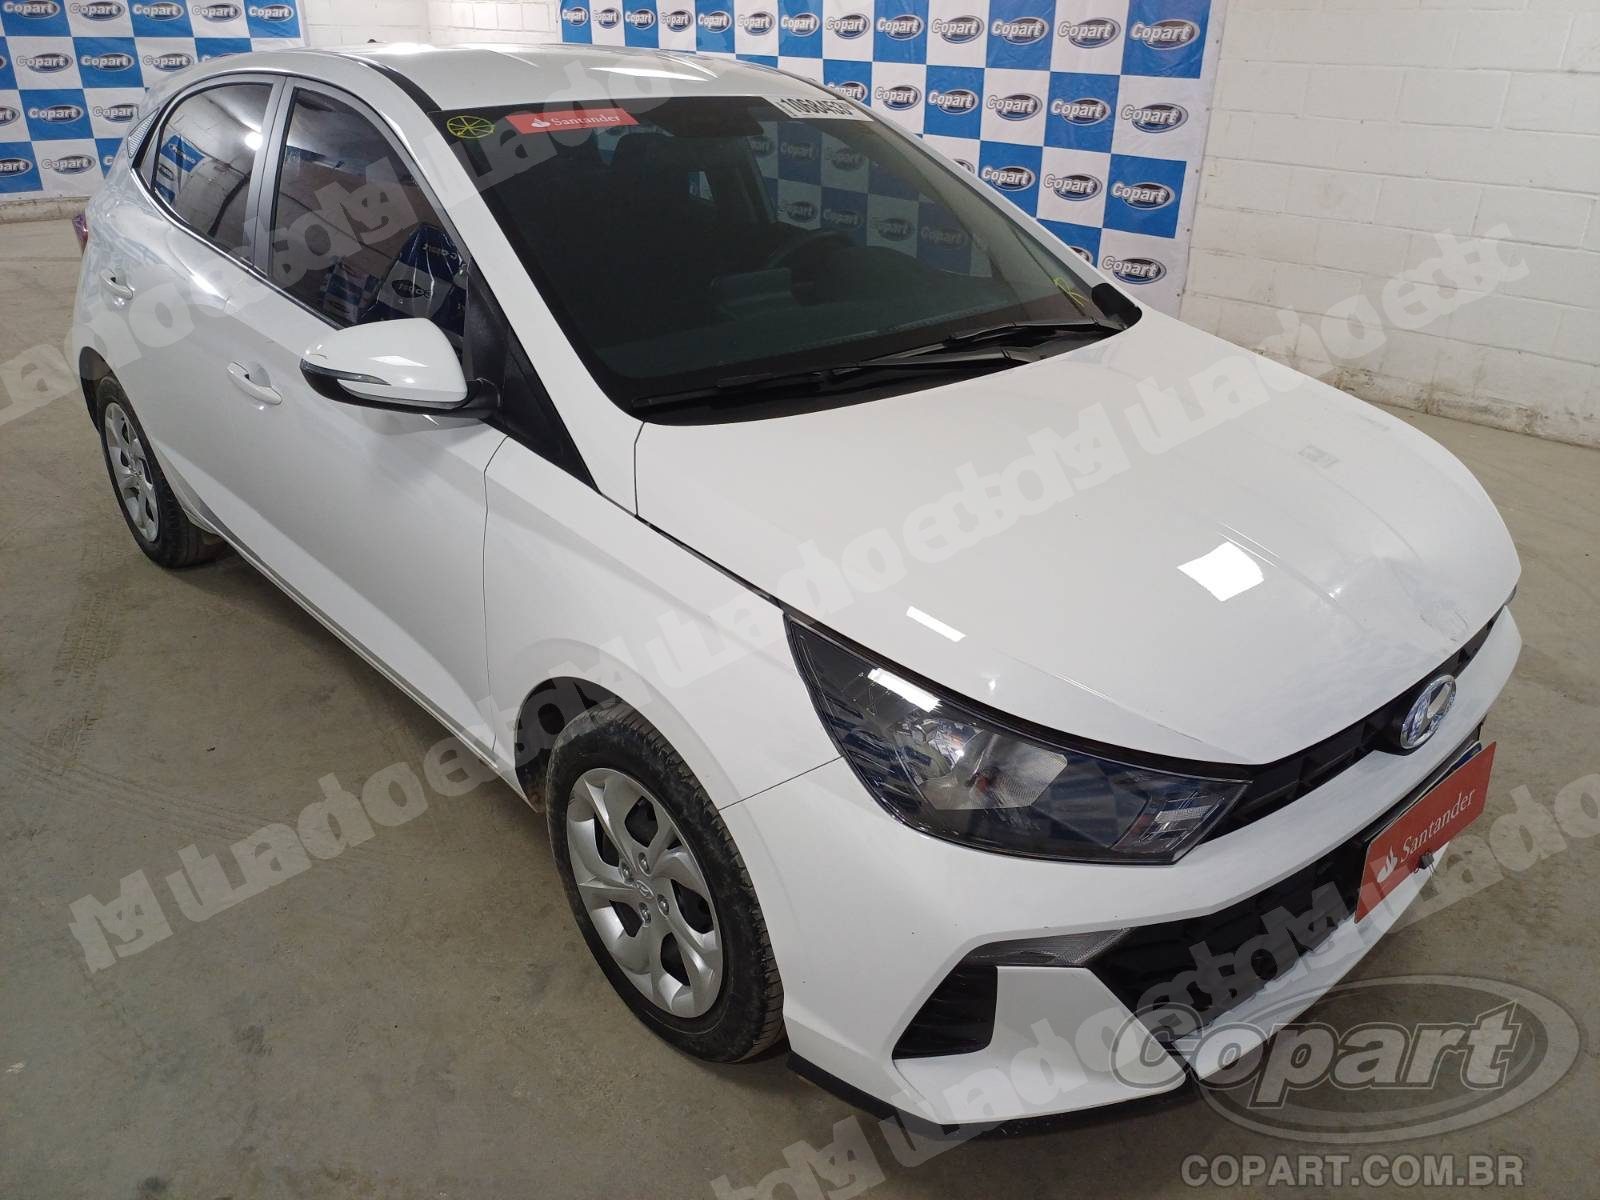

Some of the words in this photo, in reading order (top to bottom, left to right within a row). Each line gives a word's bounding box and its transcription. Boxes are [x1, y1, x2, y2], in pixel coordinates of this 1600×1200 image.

[4, 2, 54, 14] Copart
[70, 3, 119, 16] Copart
[132, 4, 179, 17] Copart
[192, 5, 236, 17] Copart
[248, 6, 290, 19] Copart
[562, 9, 585, 22] Copart
[625, 10, 651, 25] Copart
[660, 11, 689, 28] Copart
[698, 12, 728, 29] Copart
[738, 14, 770, 31] Copart
[781, 15, 815, 32] Copart
[826, 17, 864, 35] Copart
[876, 17, 919, 36] Copart
[932, 19, 978, 38] Copart
[992, 20, 1042, 40] Copart
[1058, 22, 1113, 44] Copart
[1130, 22, 1190, 47] Copart
[16, 55, 66, 69] Copart
[80, 54, 129, 68] Copart
[143, 54, 188, 68] Copart
[875, 86, 917, 105] Copart
[928, 91, 976, 110] Copart
[28, 107, 79, 121] Copart
[987, 95, 1036, 116] Copart
[1051, 100, 1104, 123] Copart
[550, 114, 621, 126] Santander
[1121, 105, 1180, 129] Copart
[41, 157, 89, 171] Copart
[981, 167, 1031, 189] Copart
[1044, 174, 1097, 198] Copart
[1111, 183, 1168, 206] Copart
[1102, 256, 1159, 282] Copart
[1399, 788, 1476, 862] Santander
